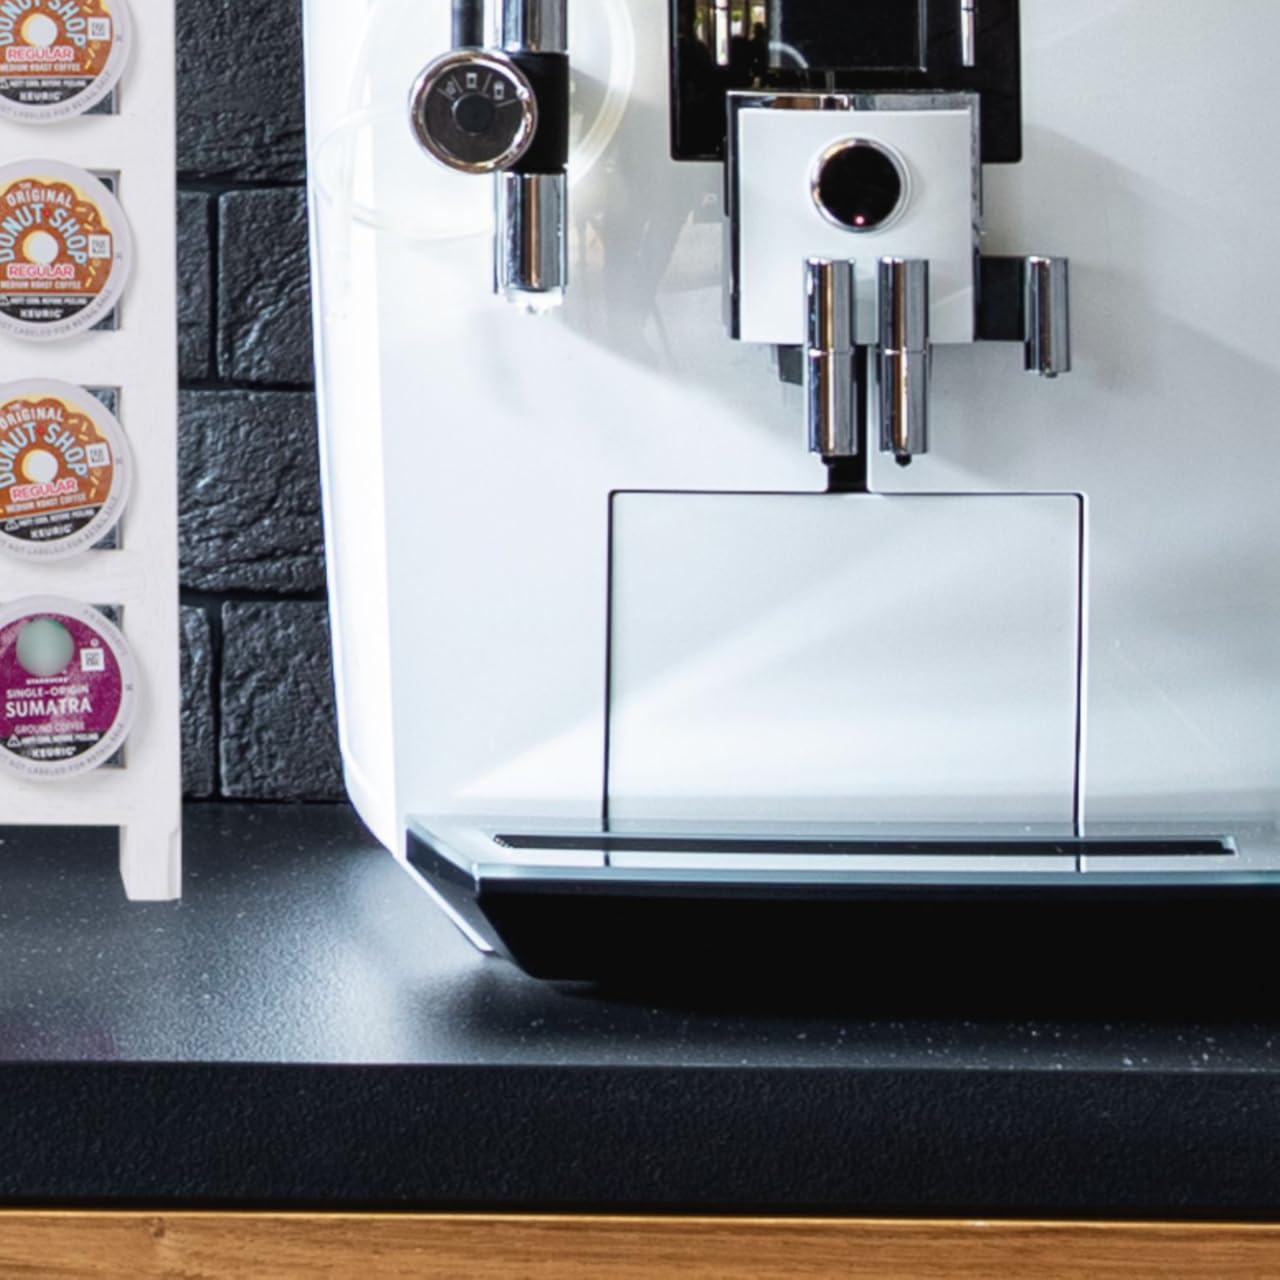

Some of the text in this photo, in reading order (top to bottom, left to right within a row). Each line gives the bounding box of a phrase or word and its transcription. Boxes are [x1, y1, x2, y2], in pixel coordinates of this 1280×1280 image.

[5, 48, 73, 62] REGULAR
[19, 92, 62, 101] KEURIG
[6, 187, 72, 208] ORIGINAL
[48, 207, 87, 264] SHOP
[6, 264, 74, 279] REGULAR
[20, 310, 62, 318] KEURIG
[43, 423, 87, 476] SHOP
[9, 479, 78, 502] REGULAR
[30, 524, 73, 540] KEURIG
[6, 684, 90, 699] SINGLE-ORIGIN
[5, 696, 93, 716] SUMATRA
[15, 720, 86, 733] GROUND COFFEE
[32, 747, 76, 758] KEURIG
